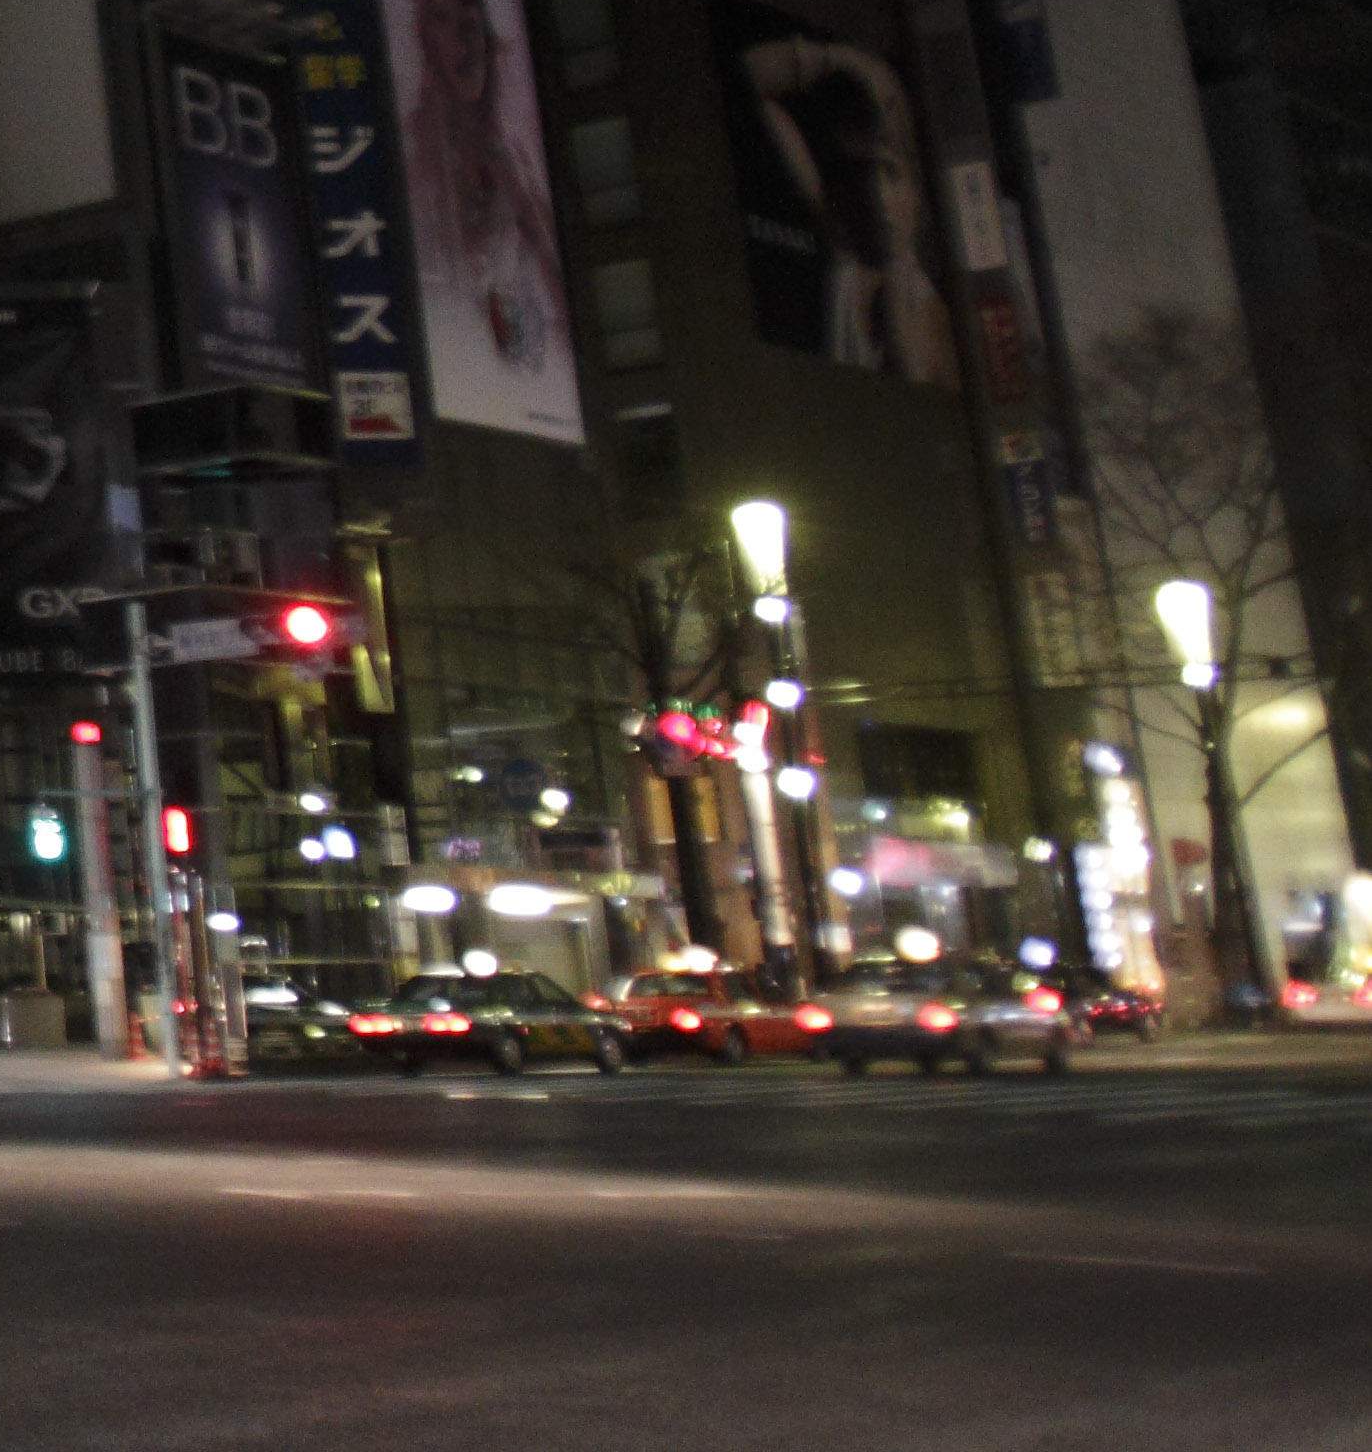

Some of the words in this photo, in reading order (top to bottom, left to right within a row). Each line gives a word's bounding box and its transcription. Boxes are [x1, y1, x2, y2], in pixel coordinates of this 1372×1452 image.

[172, 64, 278, 168] BB
[307, 123, 399, 346] ジオス
